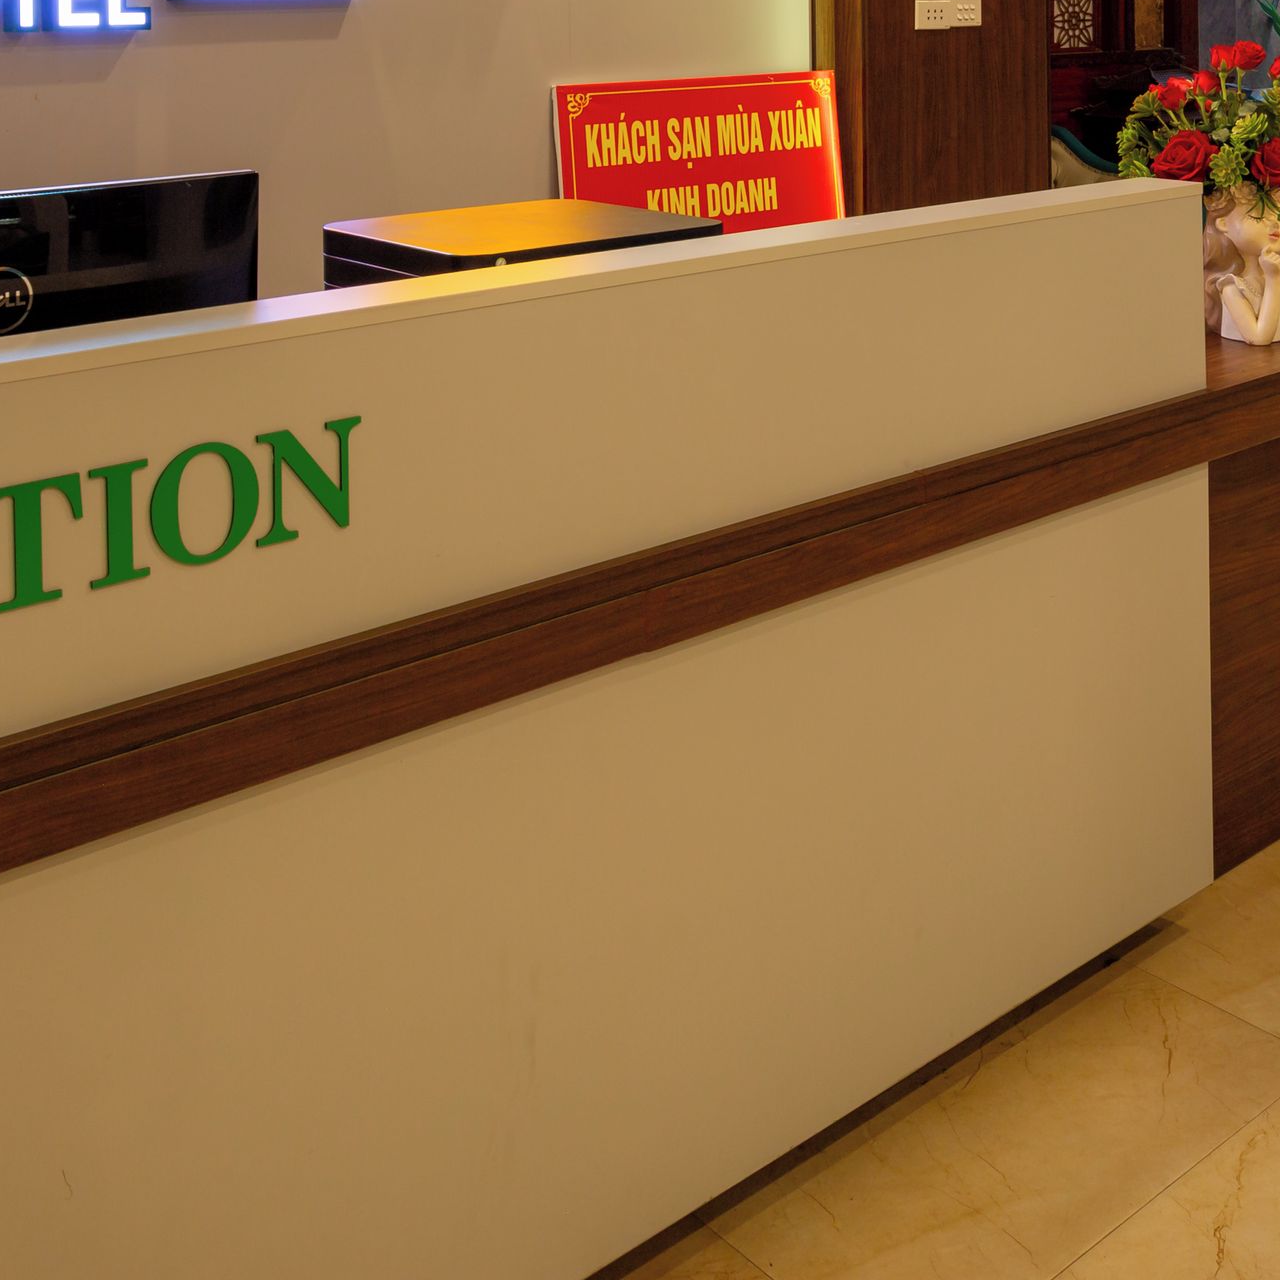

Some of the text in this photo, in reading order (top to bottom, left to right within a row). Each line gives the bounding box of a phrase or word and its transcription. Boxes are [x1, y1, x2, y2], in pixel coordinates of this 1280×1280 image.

[584, 100, 823, 169] KHÁCH SẠN MÙA XUÂN
[646, 176, 779, 218] KINH DOANH
